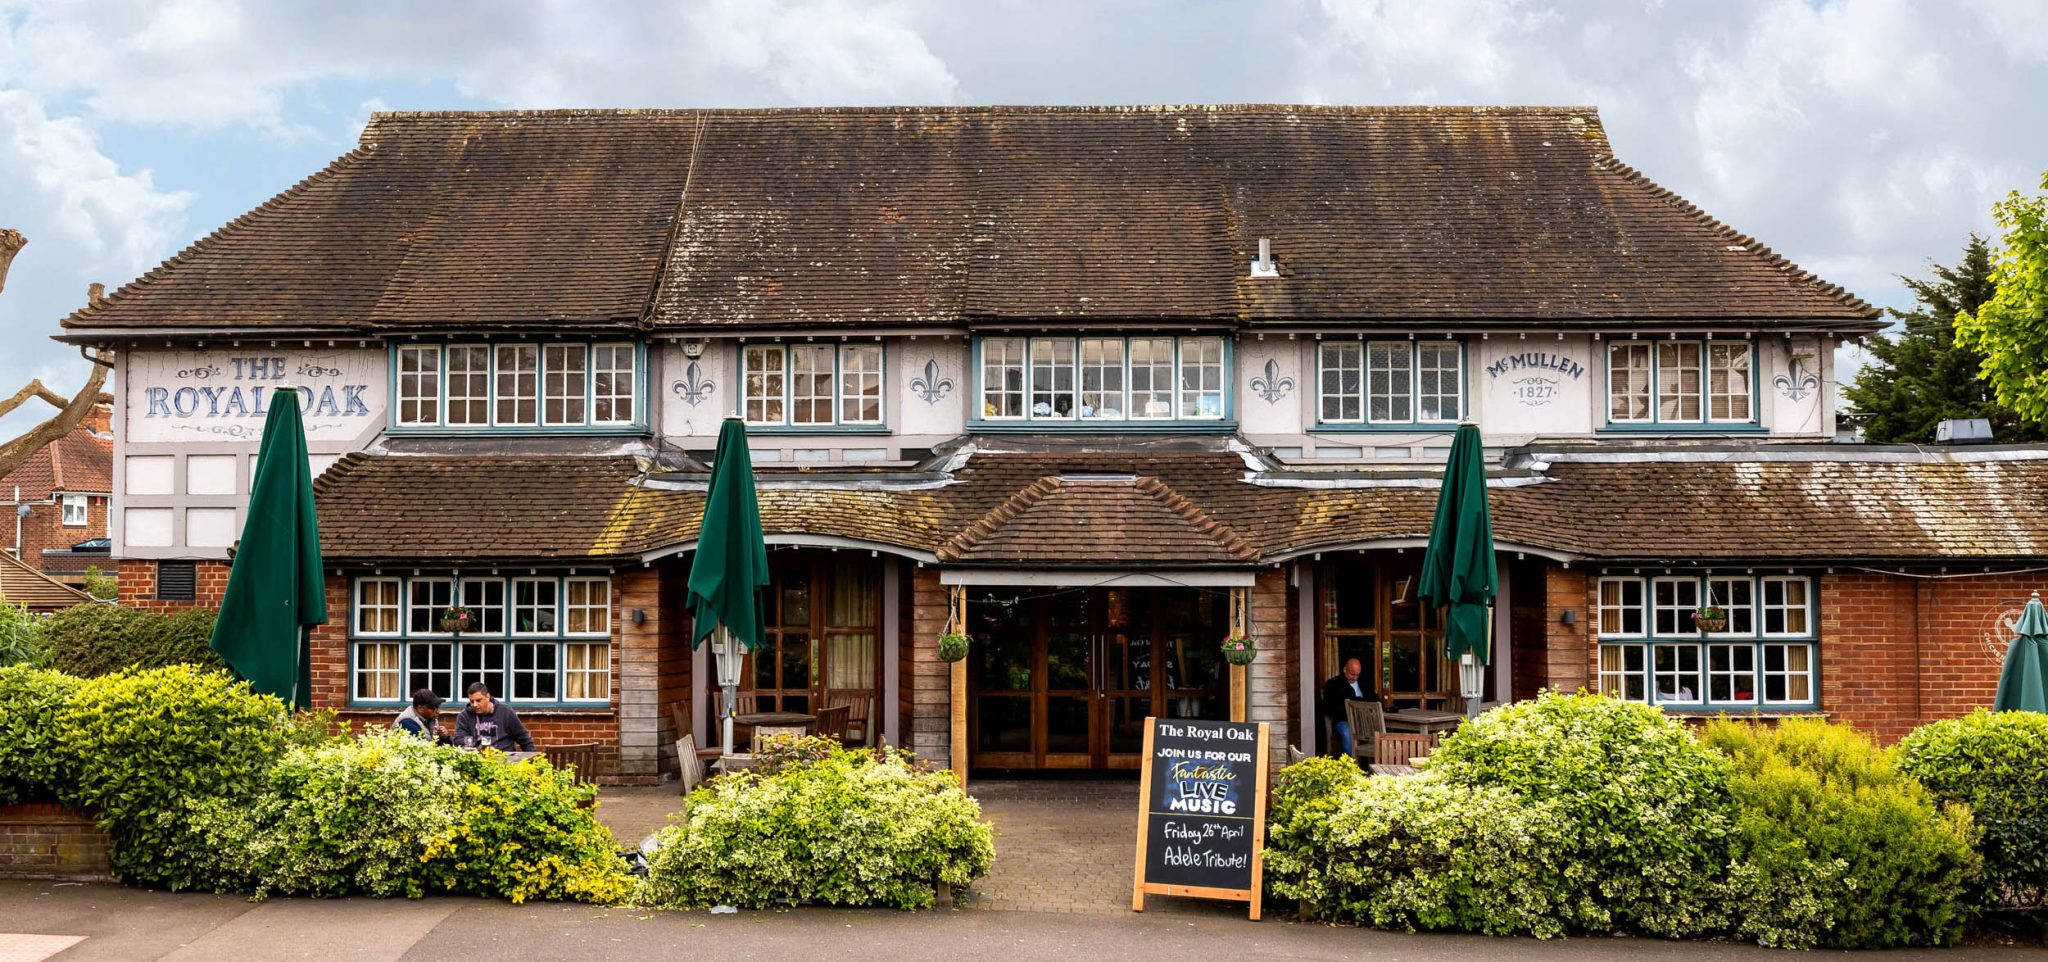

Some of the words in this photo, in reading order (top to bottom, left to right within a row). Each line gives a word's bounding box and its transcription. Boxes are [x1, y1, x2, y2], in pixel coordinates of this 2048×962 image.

[231, 357, 287, 380] THE
[145, 385, 270, 418] ROYAL
[1519, 386, 1553, 398] 1827
[1159, 724, 1184, 737] The
[1187, 725, 1223, 741] Royal
[1226, 727, 1254, 741] Oak
[1157, 747, 1185, 758] JOIN
[1187, 750, 1202, 760] US
[1204, 751, 1226, 761] FOR
[1227, 752, 1252, 762] OUR
[1171, 761, 1237, 783] Fantastic
[1179, 781, 1229, 801] LIVE
[1169, 798, 1236, 815] MUSIC
[1164, 821, 1203, 845] Friday
[1202, 823, 1221, 838] 26th
[1221, 825, 1244, 841] April
[1164, 845, 1202, 867] Adele
[1202, 849, 1247, 869] Tribute!
